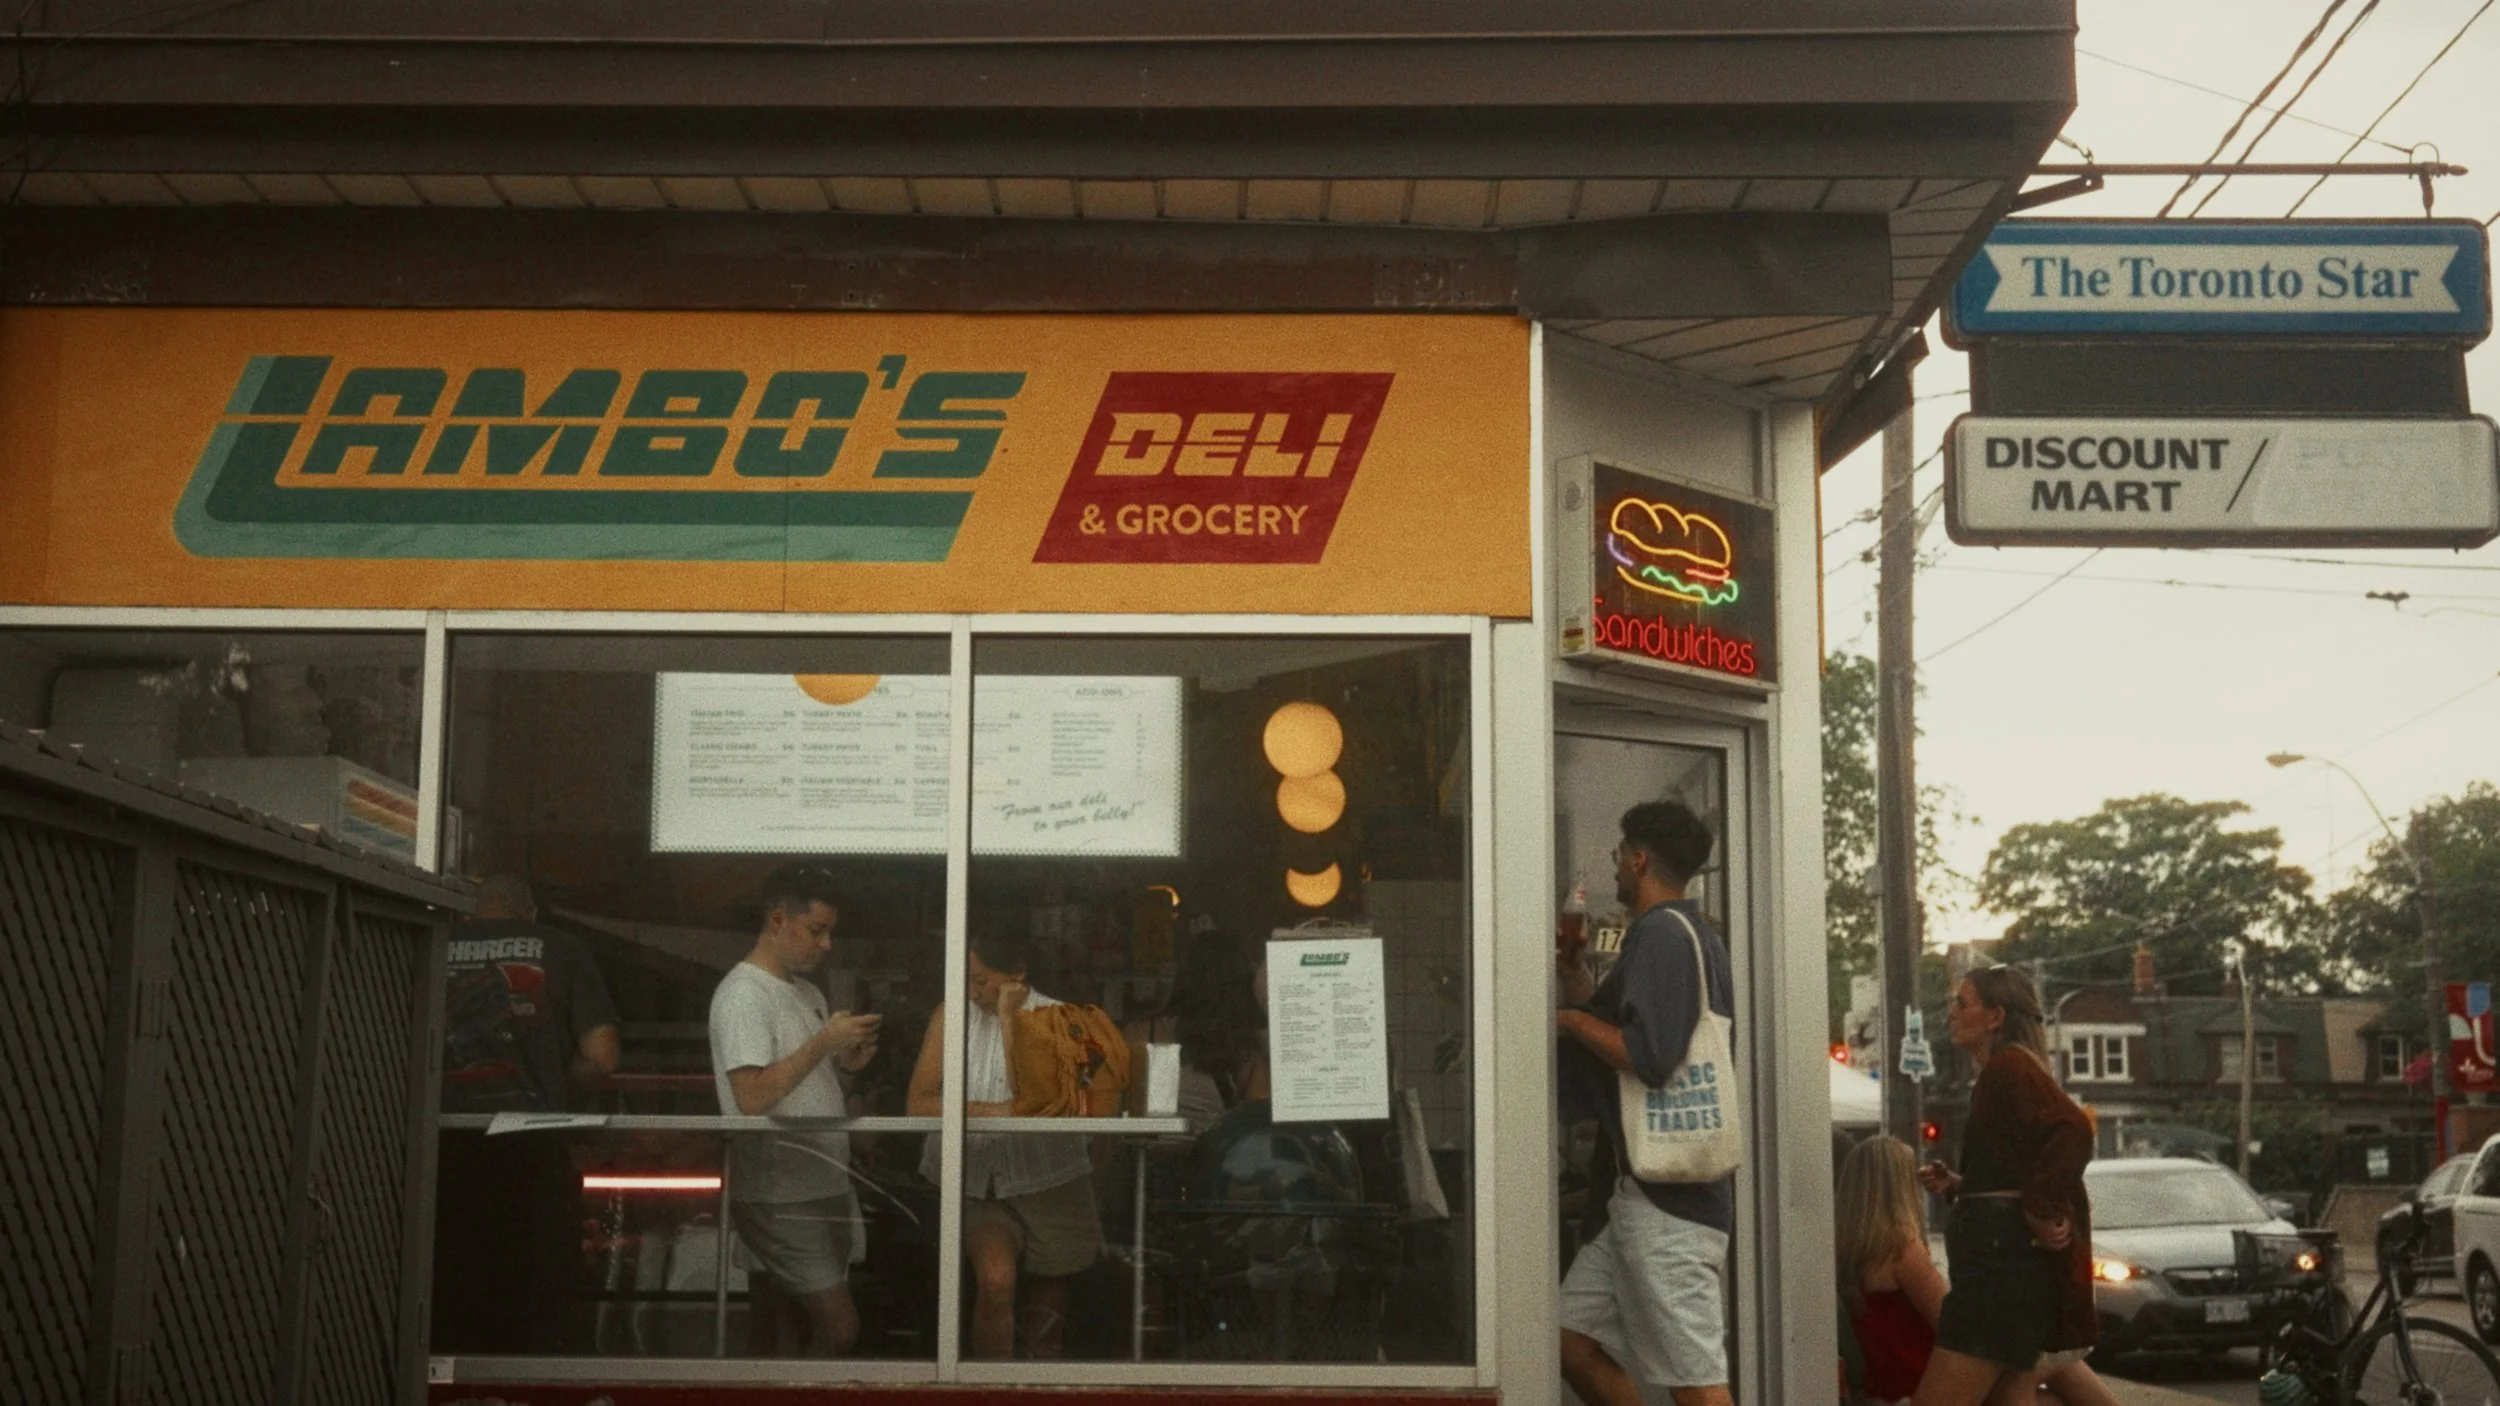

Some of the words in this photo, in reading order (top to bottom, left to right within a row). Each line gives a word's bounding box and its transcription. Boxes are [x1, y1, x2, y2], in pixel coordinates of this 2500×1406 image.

[2021, 256, 2110, 298] The
[2120, 257, 2303, 298] Toronto
[2316, 257, 2420, 298] Star
[172, 354, 1027, 561] LAMBO'S
[1095, 412, 1352, 478] DELI
[1985, 436, 2229, 470] DISCOUNT
[2030, 481, 2181, 513] MART
[1078, 503, 1106, 535] &
[1115, 503, 1309, 536] GROCERY
[447, 936, 544, 962] HARGER
[1647, 1107, 1723, 1132] TRADES
